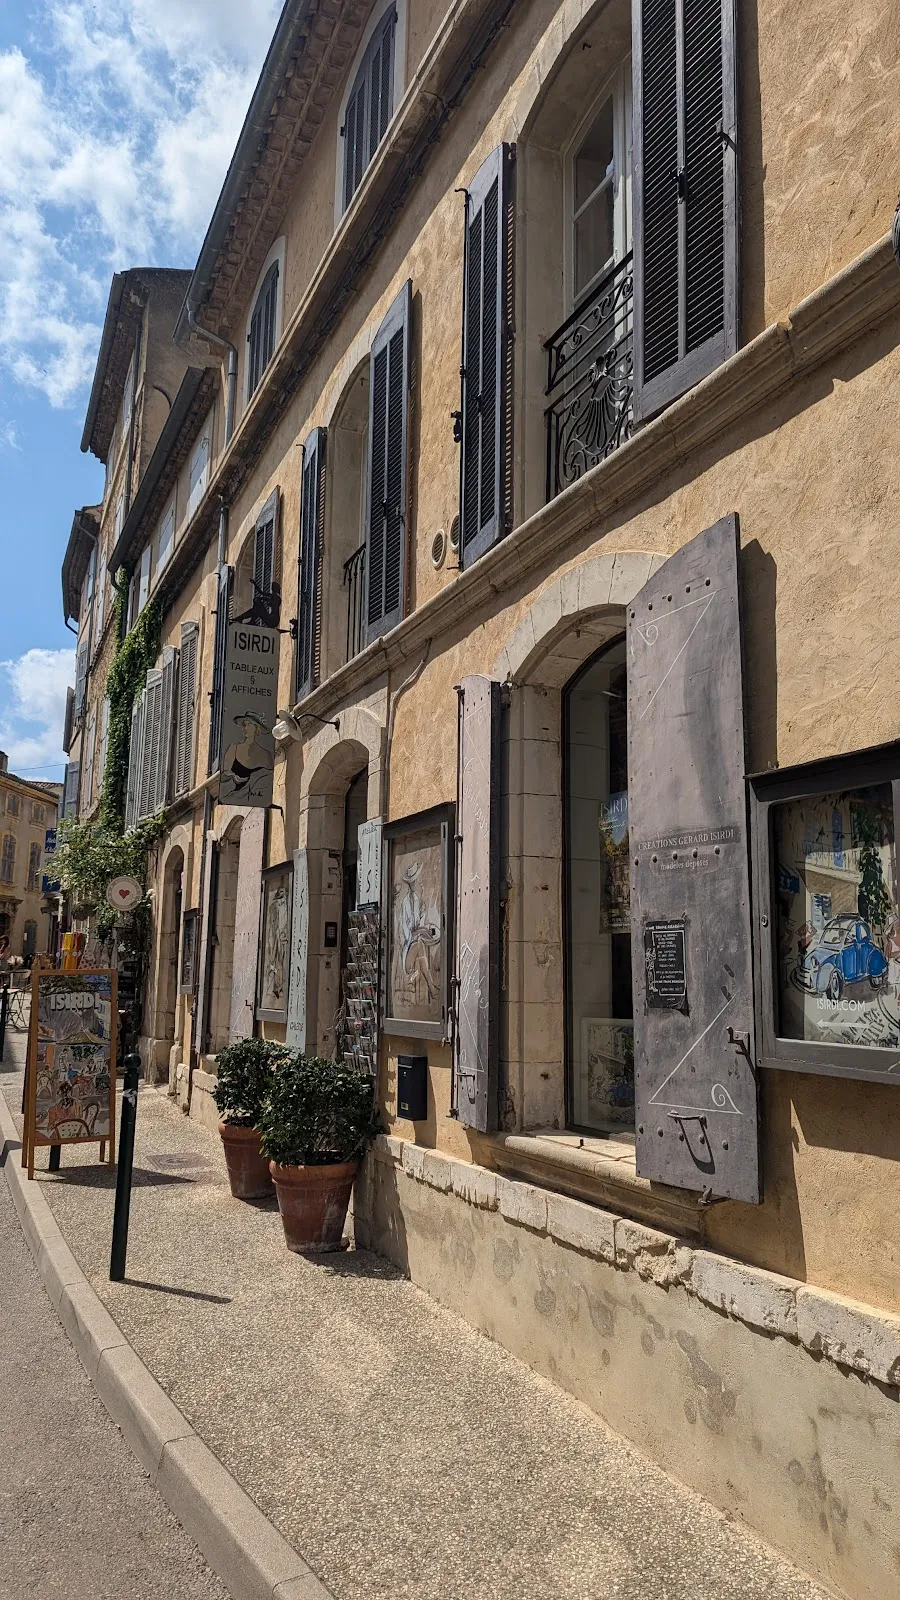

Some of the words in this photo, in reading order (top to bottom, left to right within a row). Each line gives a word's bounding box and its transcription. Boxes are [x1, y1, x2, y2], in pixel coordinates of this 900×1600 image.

[234, 631, 275, 654] ISIRDI
[230, 662, 274, 675] TABLEAUX
[231, 685, 273, 697] AFFICHES
[600, 797, 628, 817] ISIRD
[638, 837, 678, 851] CREATIONS
[710, 829, 734, 841] ISIRDI
[50, 991, 101, 1011] ISIRDI
[816, 999, 866, 1011] ISIRDI.COM
